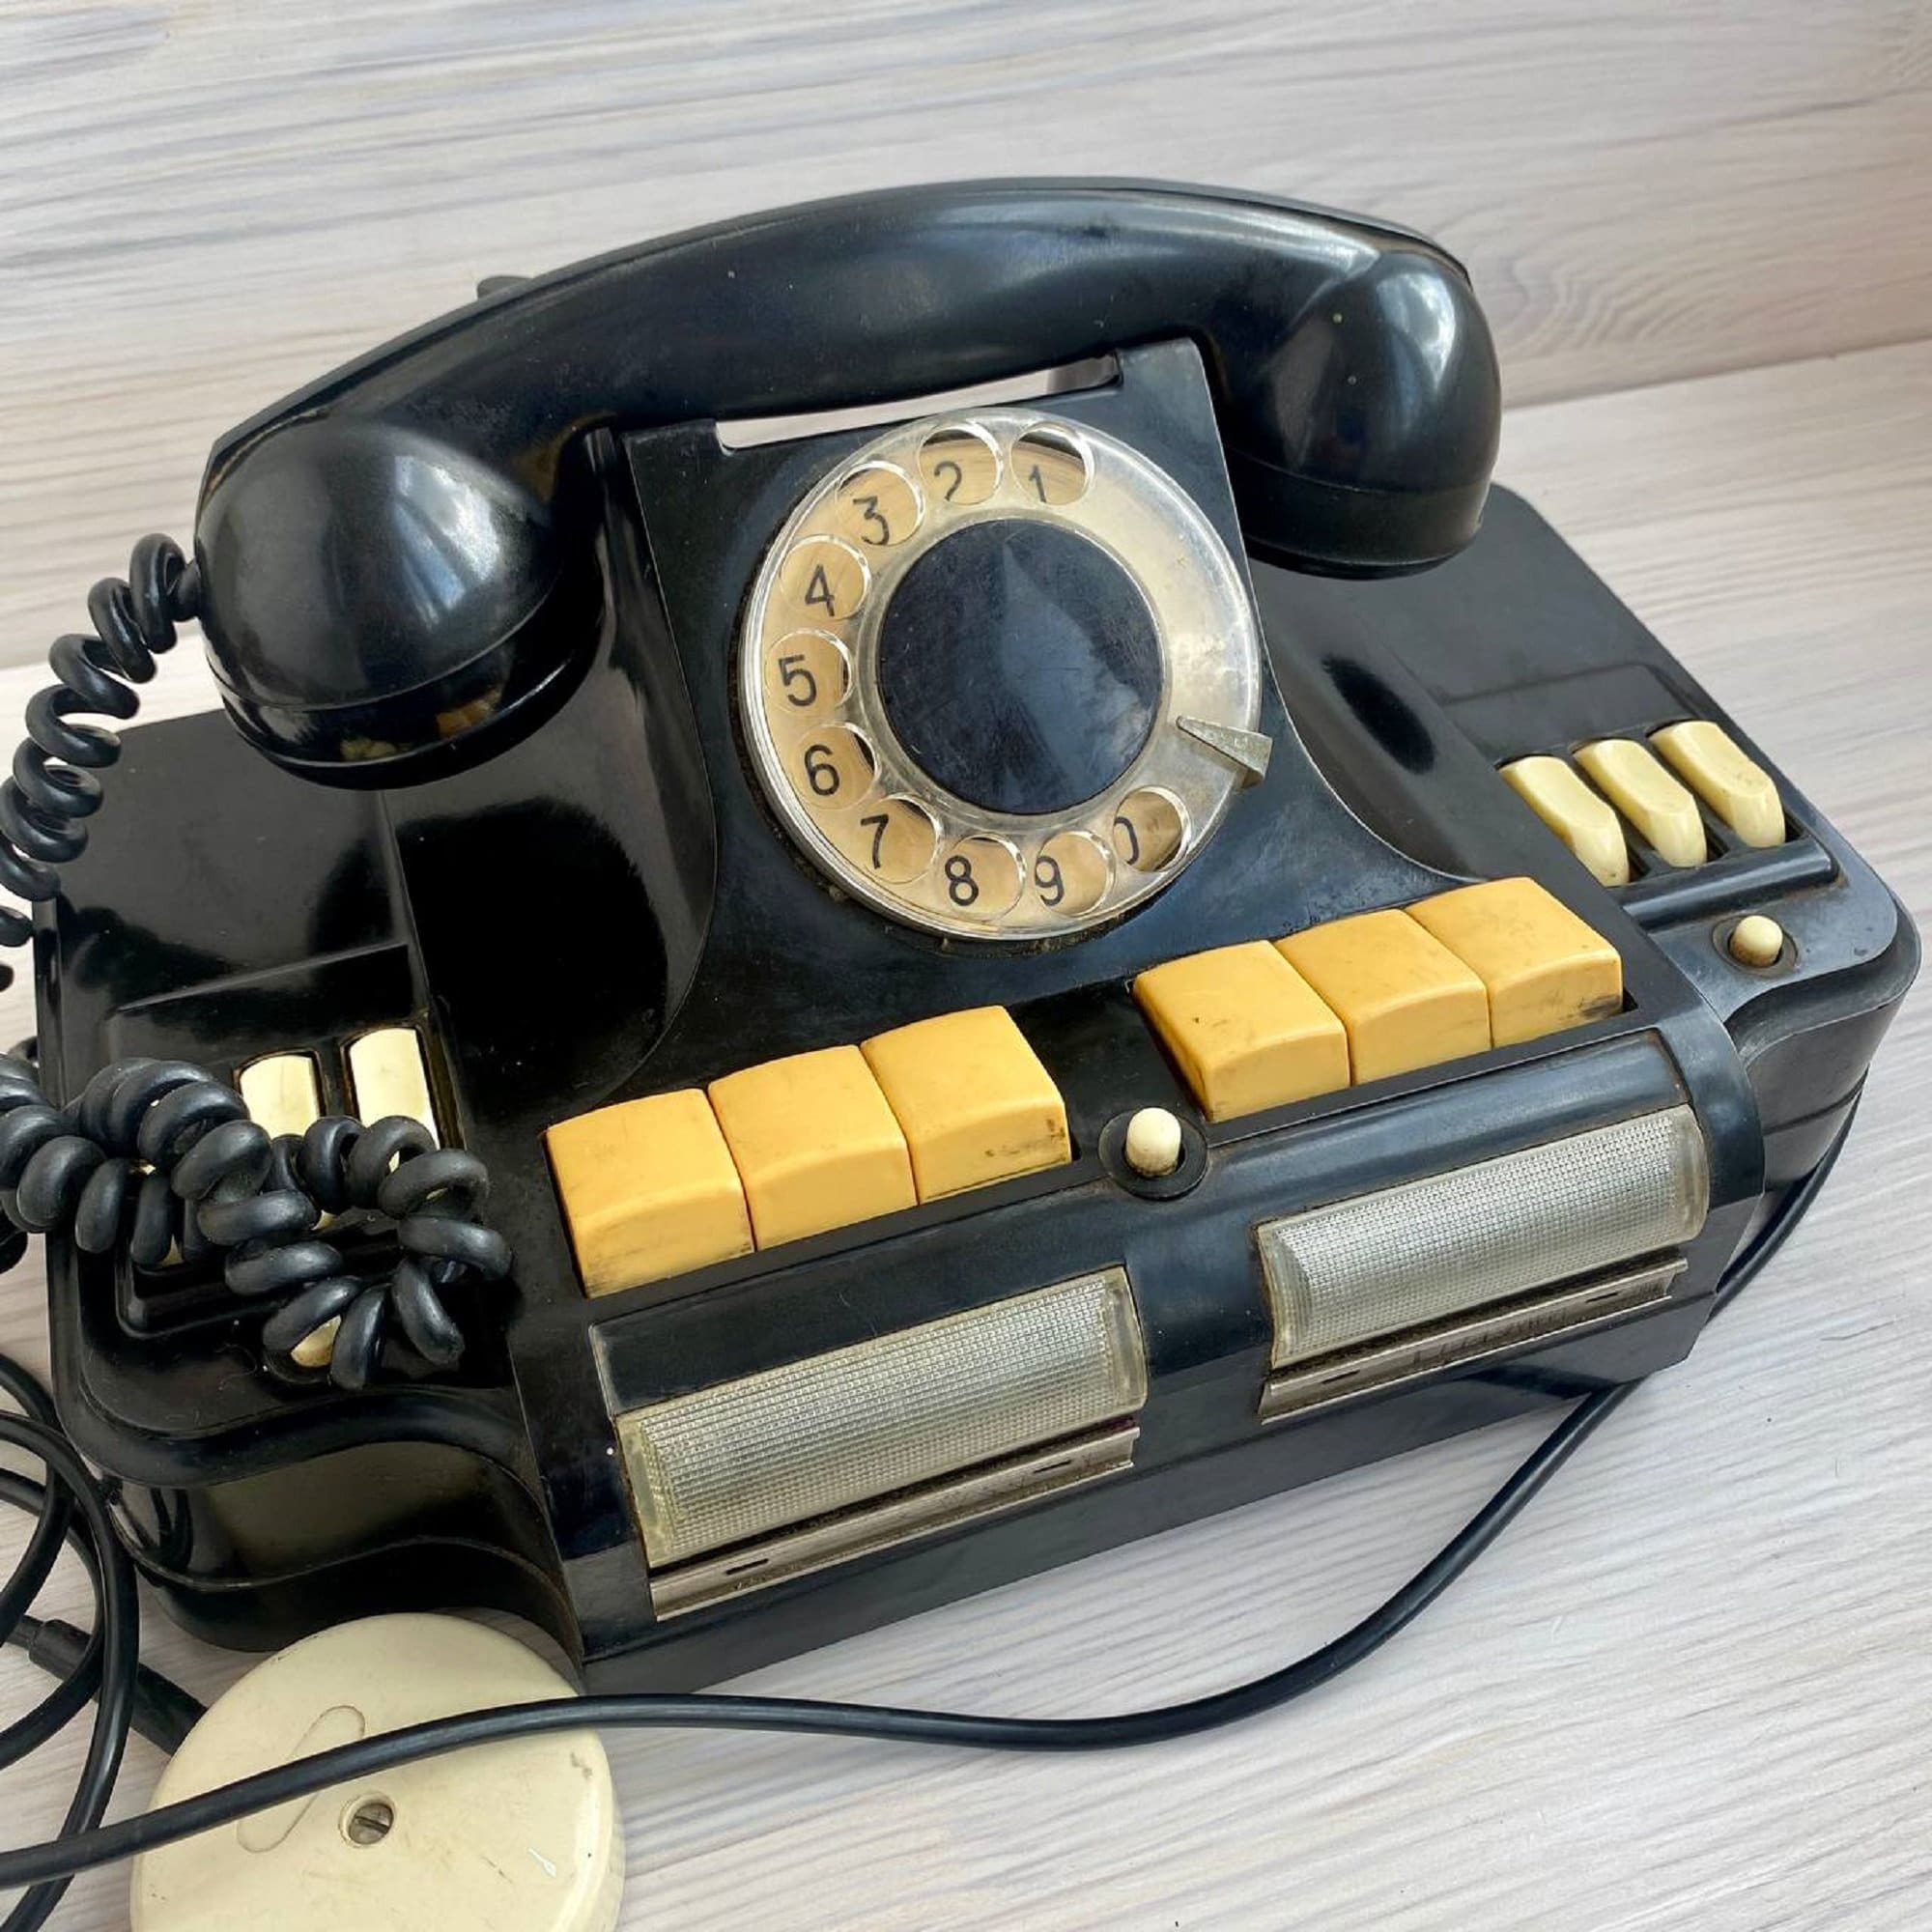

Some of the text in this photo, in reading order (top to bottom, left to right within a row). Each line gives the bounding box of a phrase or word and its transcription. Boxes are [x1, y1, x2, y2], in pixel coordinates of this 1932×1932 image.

[1029, 466, 1047, 502] 1
[853, 497, 889, 545] 3
[805, 565, 835, 616] 4
[779, 655, 816, 706] 5
[804, 745, 839, 795] 6
[862, 814, 889, 868] 7
[945, 856, 979, 906] 8
[1036, 856, 1063, 906] 9
